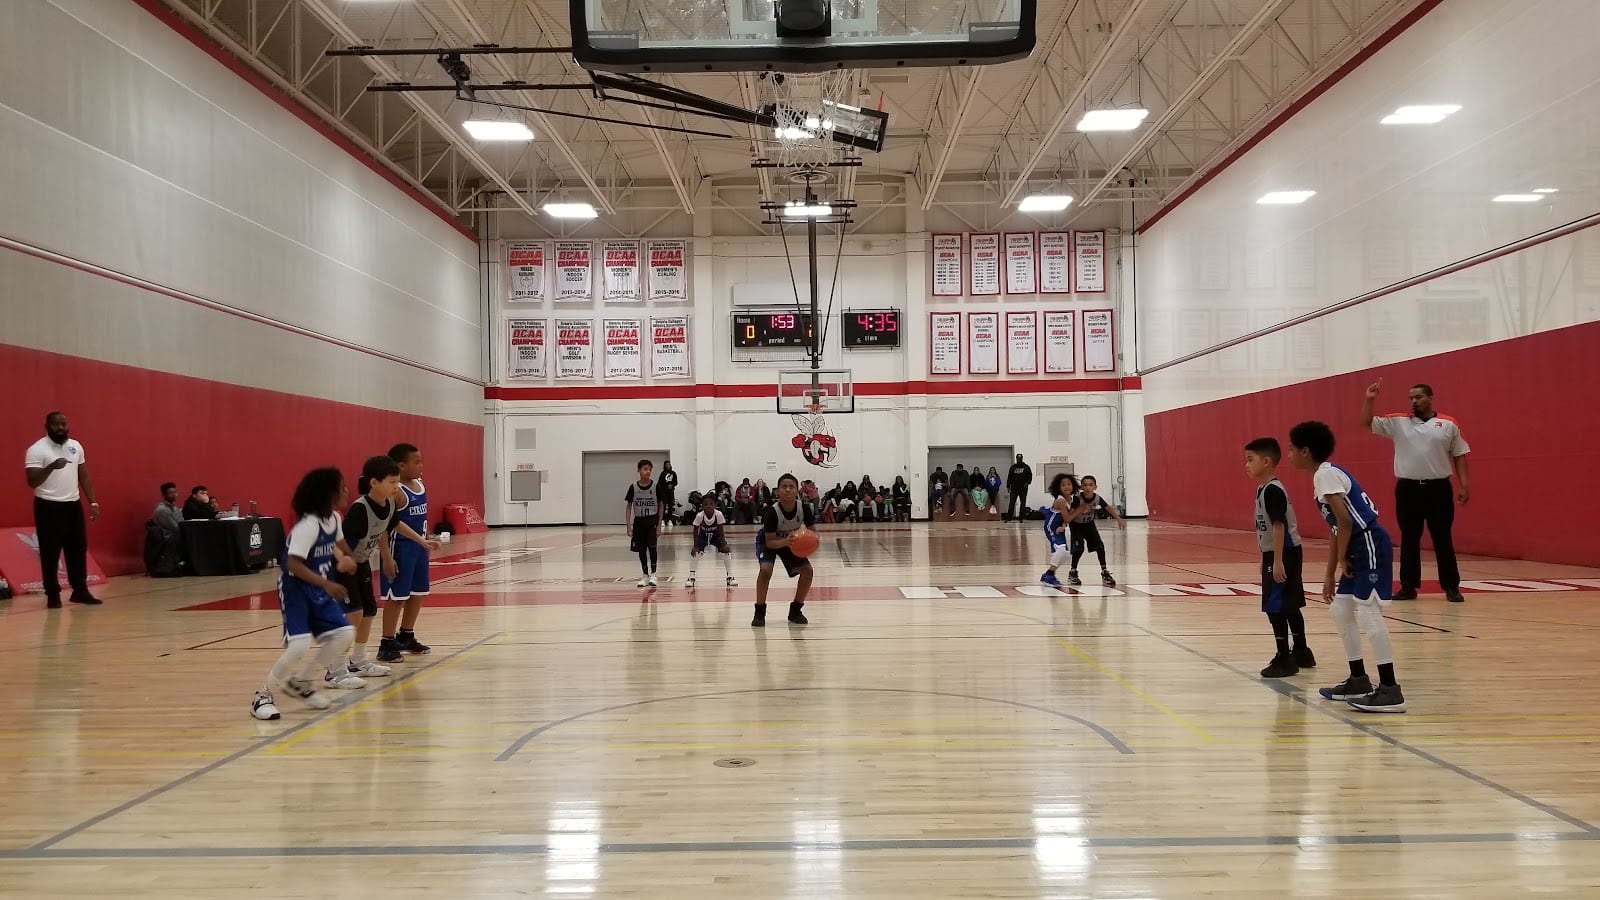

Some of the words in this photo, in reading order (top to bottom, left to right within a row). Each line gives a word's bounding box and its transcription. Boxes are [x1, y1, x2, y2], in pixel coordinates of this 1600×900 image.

[559, 251, 588, 260] OCAA
[607, 251, 636, 260] OCAA
[652, 250, 681, 260] OCAA
[771, 315, 794, 328] 1:53
[858, 313, 897, 332] 4:35
[513, 330, 542, 338] OCAA
[608, 330, 637, 338] OCAA
[655, 328, 684, 337] OCAA
[746, 326, 755, 338] 0
